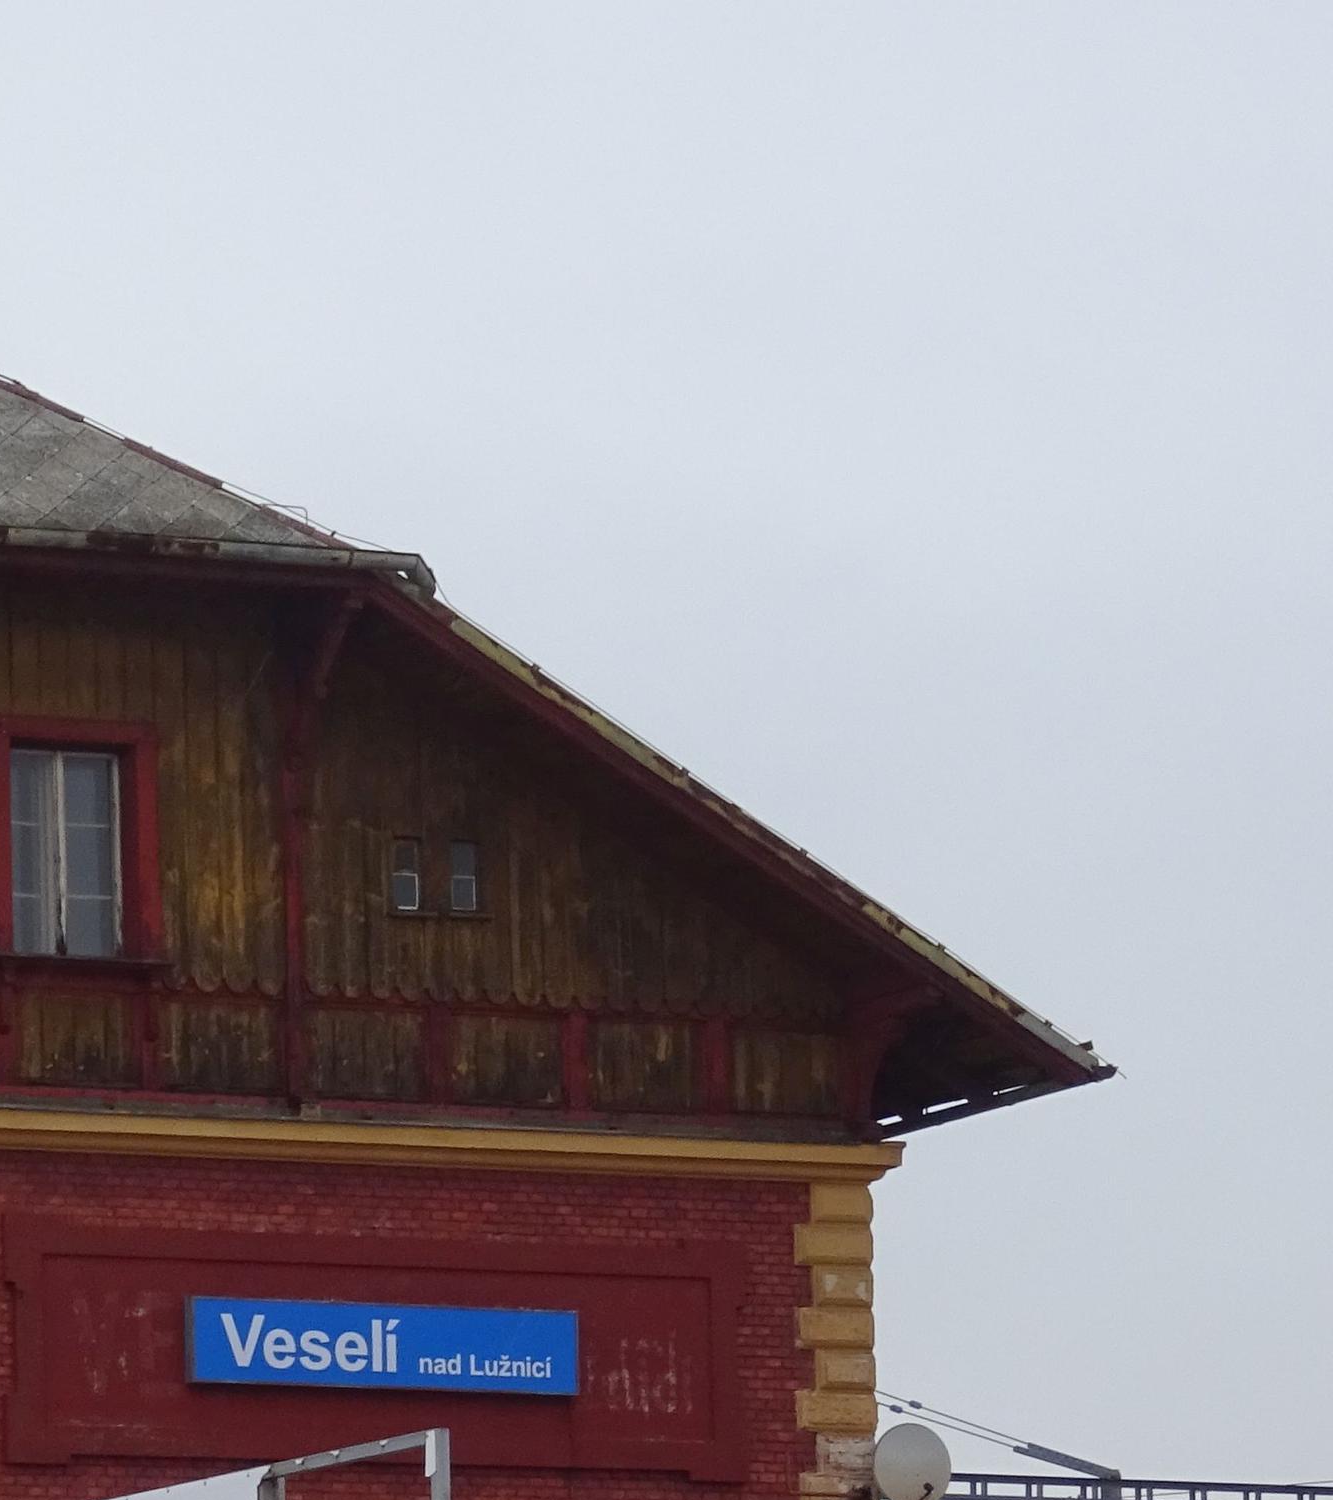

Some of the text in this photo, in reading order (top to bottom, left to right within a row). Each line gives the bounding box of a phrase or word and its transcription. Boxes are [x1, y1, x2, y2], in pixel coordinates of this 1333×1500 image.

[220, 1312, 552, 1379] Veselí nad Lužnicí
